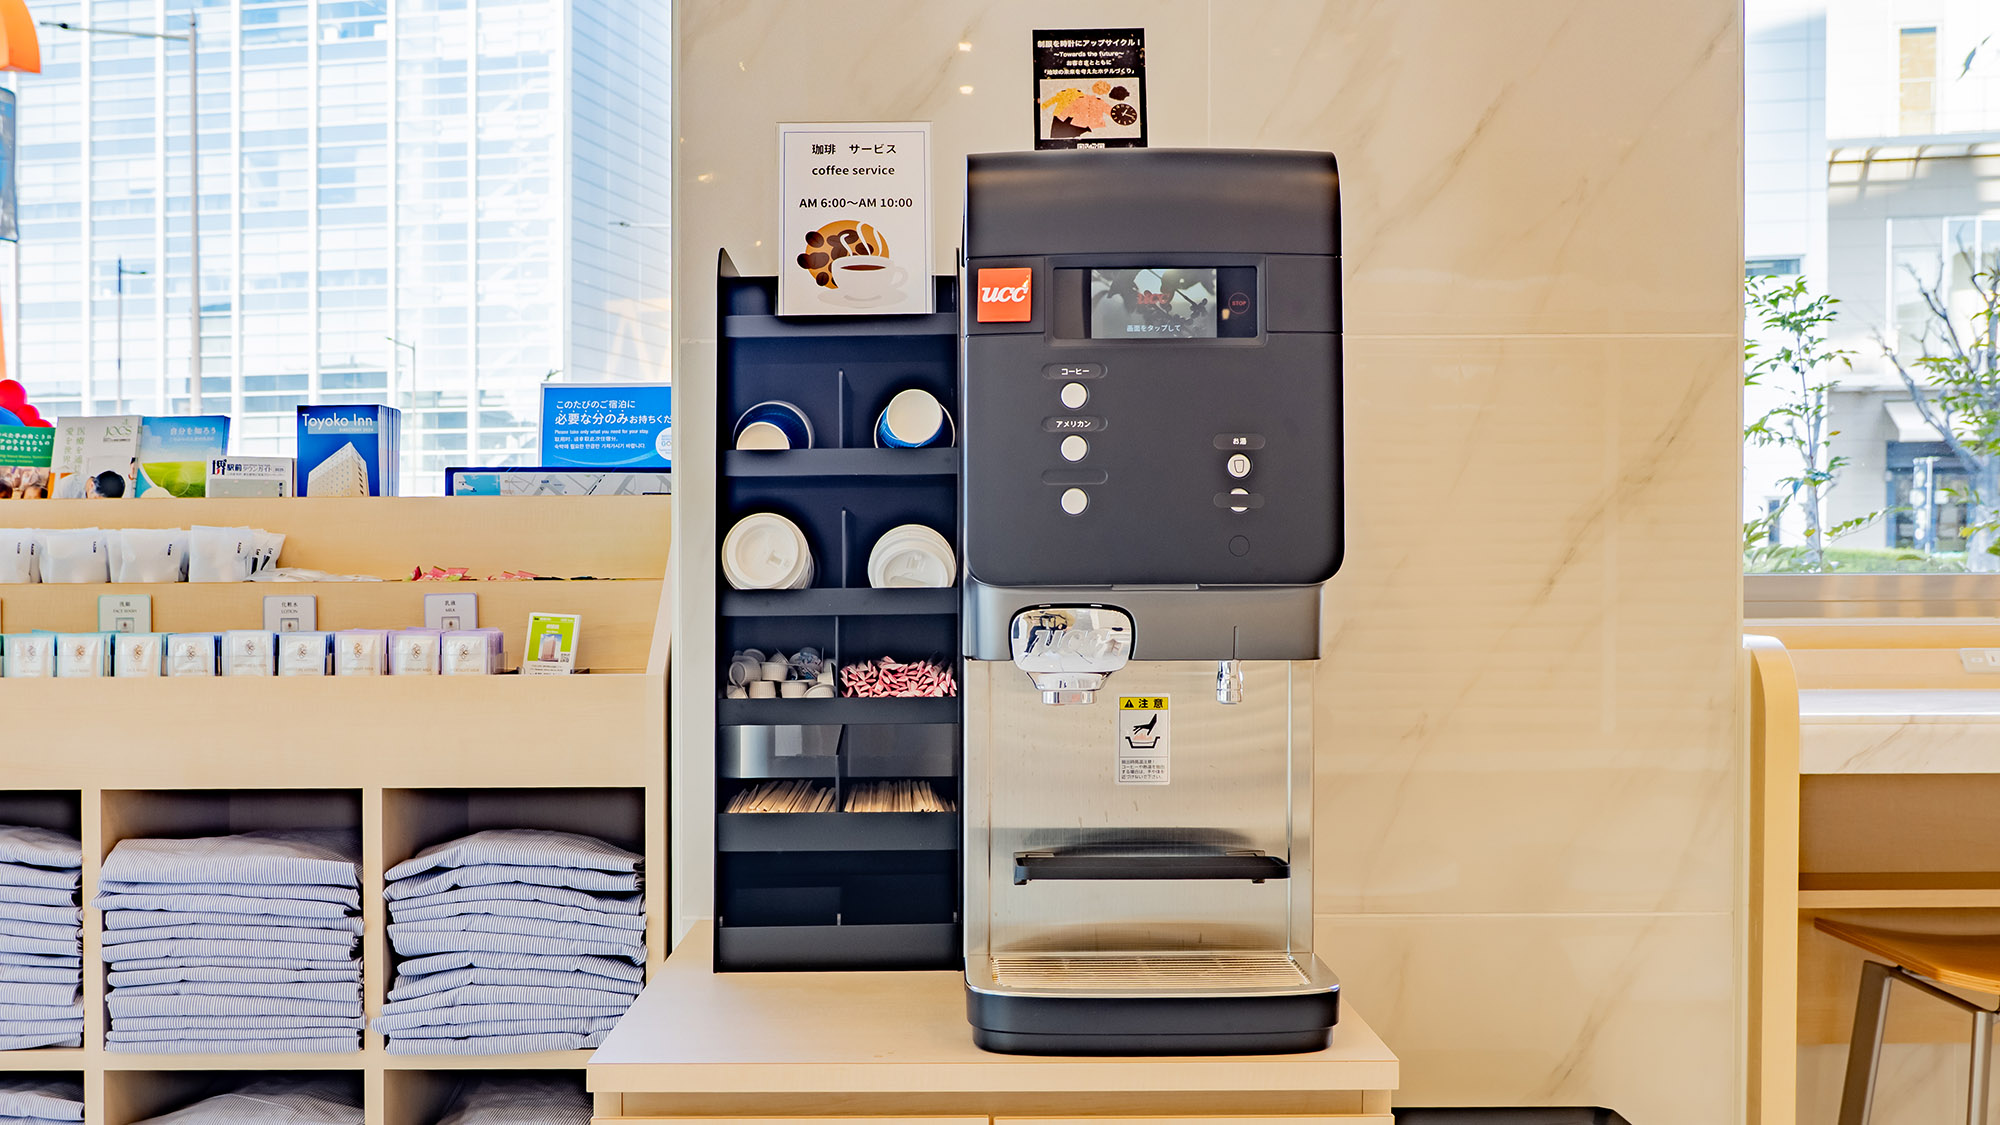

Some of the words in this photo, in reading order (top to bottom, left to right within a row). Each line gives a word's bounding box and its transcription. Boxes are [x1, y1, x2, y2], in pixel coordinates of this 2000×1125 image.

[811, 144, 837, 155] 珈琲
[849, 144, 897, 155] サービス
[811, 165, 849, 176] coffee
[852, 165, 896, 176] service
[799, 198, 818, 208] AM
[880, 198, 913, 208] 10:00
[1126, 324, 1181, 333] 画面をタップして
[1061, 367, 1090, 376] コーヒー
[556, 400, 636, 409] このたびのご宿泊に
[302, 412, 349, 430] Toyoko
[353, 413, 373, 427] Inn
[1055, 420, 1091, 428] アメリカン
[1232, 437, 1247, 446] お湯
[1138, 698, 1164, 709] 注意
